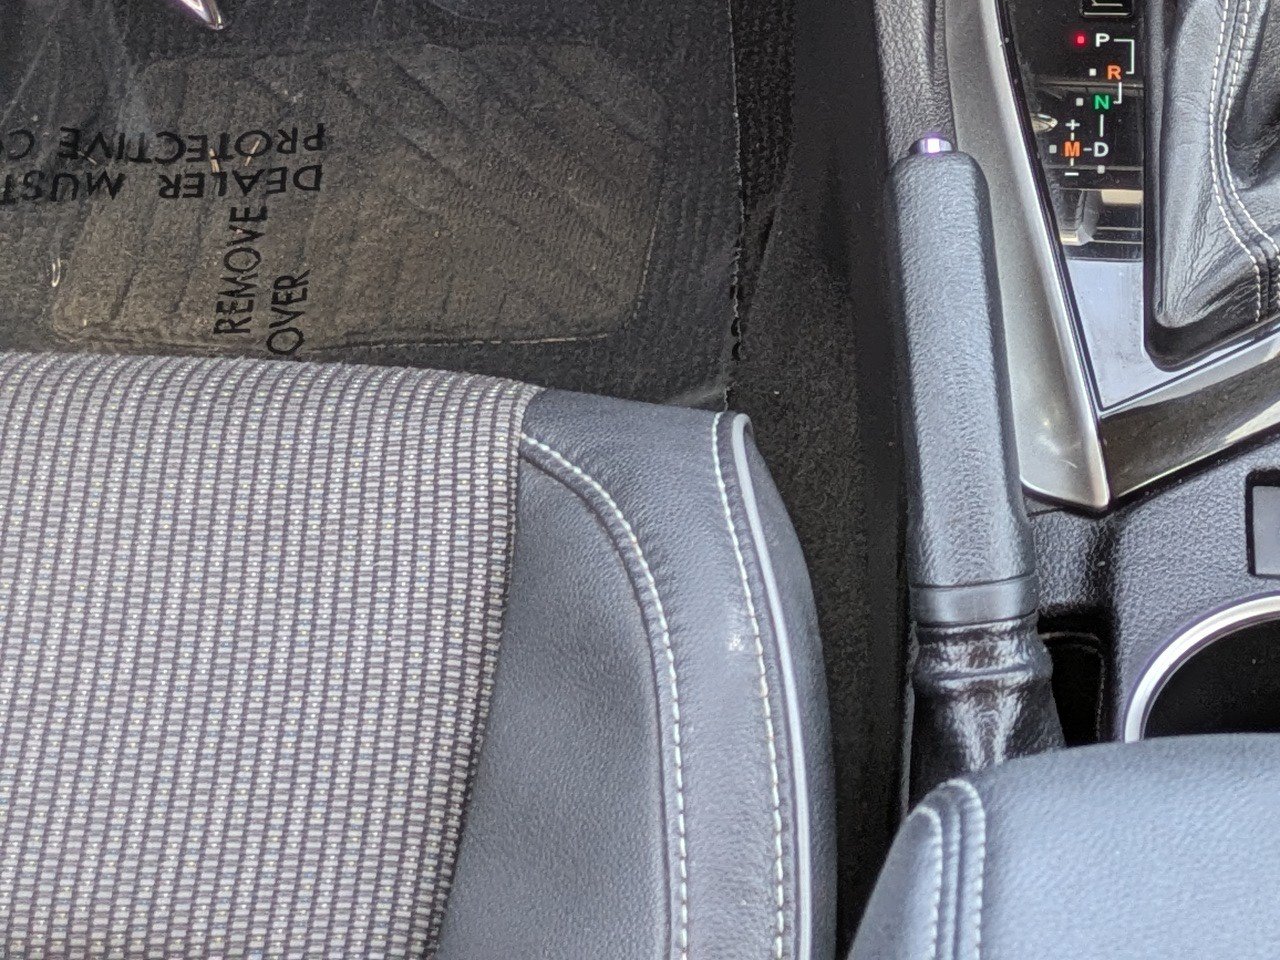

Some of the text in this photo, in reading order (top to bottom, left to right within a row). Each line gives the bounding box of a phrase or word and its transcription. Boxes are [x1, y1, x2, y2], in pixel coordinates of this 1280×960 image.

[1094, 32, 1111, 48] P
[1106, 64, 1122, 81] R
[1094, 94, 1110, 111] N
[58, 122, 327, 165] PROTECTIVE
[1063, 141, 1081, 158] M
[1093, 141, 1109, 158] D
[158, 163, 323, 200] DEALER
[213, 205, 268, 336] REMOVE
[265, 268, 312, 357] OVER
